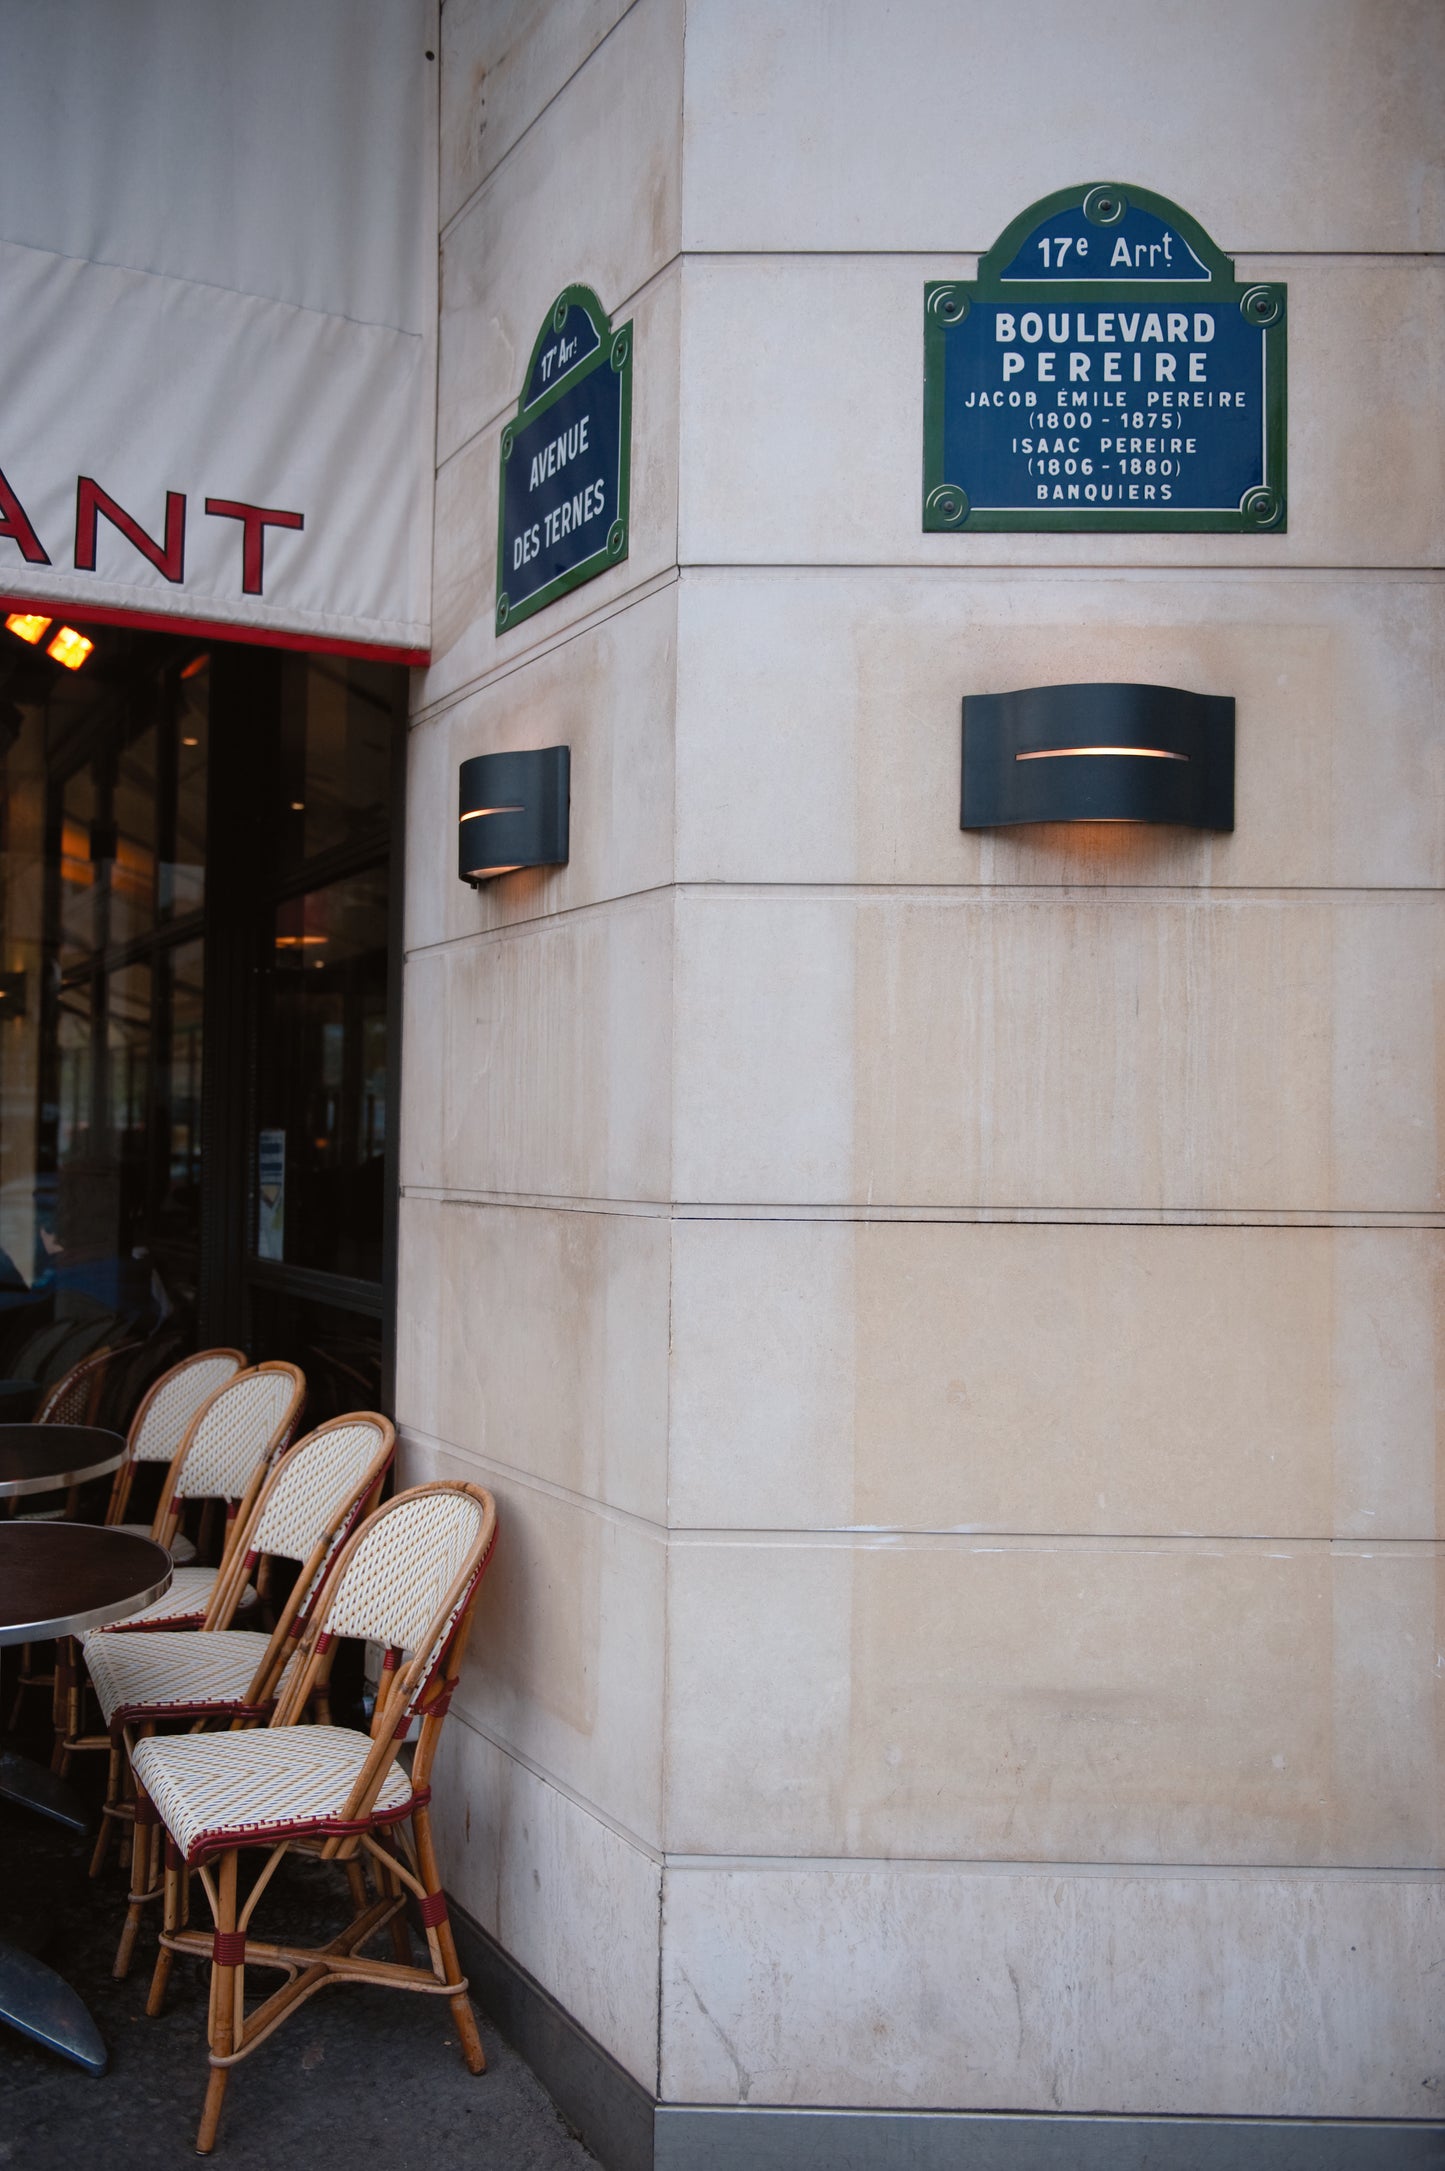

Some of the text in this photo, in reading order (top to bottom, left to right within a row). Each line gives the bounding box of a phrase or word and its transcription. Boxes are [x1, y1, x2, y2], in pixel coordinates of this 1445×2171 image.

[1039, 238, 1088, 267] 17e
[996, 312, 1214, 343] BOULEVARD
[1003, 353, 1206, 382] PEREIRE
[965, 389, 1245, 407] JACOB ÉMILE PEREIRE
[529, 415, 590, 492] AVENUE
[1013, 438, 1196, 453] ISAAC PEREIRE
[1038, 484, 1171, 501] BANQUIERS
[513, 478, 605, 571] DES TERNES
